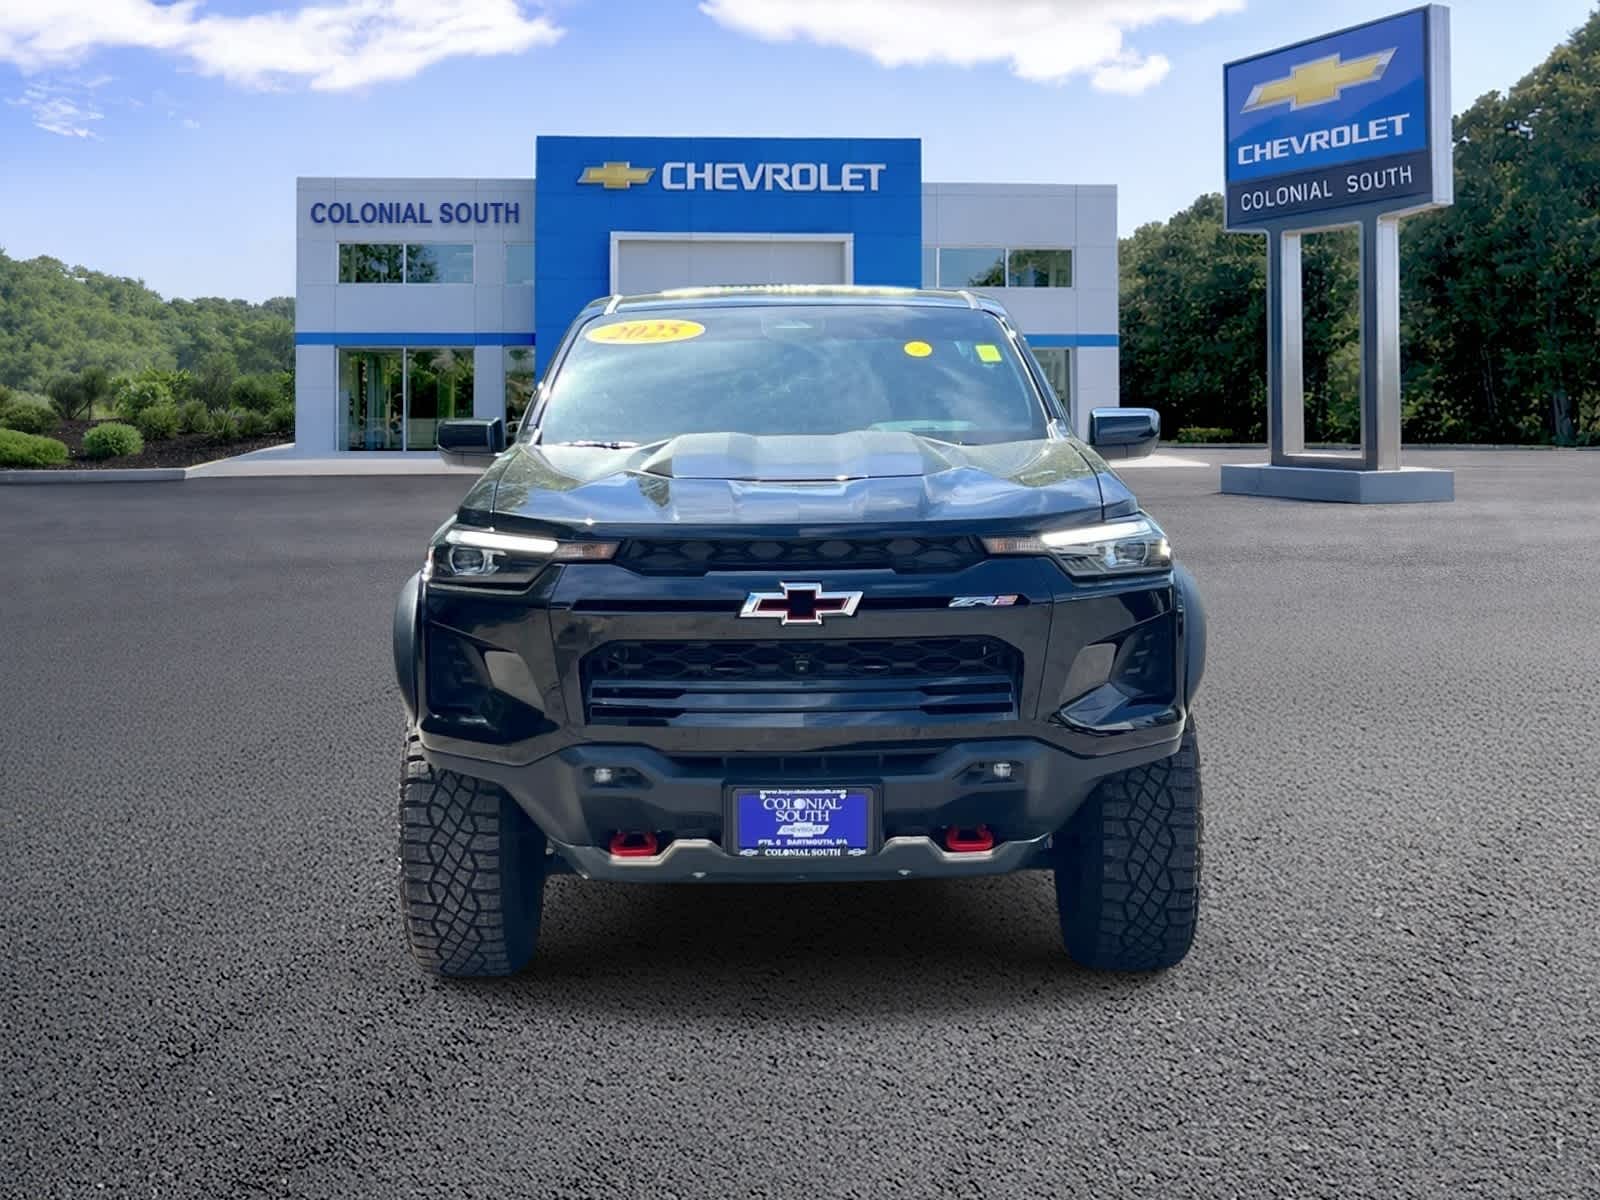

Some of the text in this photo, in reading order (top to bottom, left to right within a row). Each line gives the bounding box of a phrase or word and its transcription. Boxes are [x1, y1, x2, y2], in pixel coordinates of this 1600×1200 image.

[1237, 113, 1410, 165] CHEVROLET
[662, 162, 887, 192] CHEVROLET
[1240, 165, 1413, 211] COLONIAL SOUTH
[310, 202, 520, 224] COLONIAL SOUTH
[609, 321, 688, 340] 2025
[763, 798, 842, 810] COLONIAL
[775, 810, 830, 822] SOUTH
[764, 848, 841, 856] COLONIAL SOUTH
